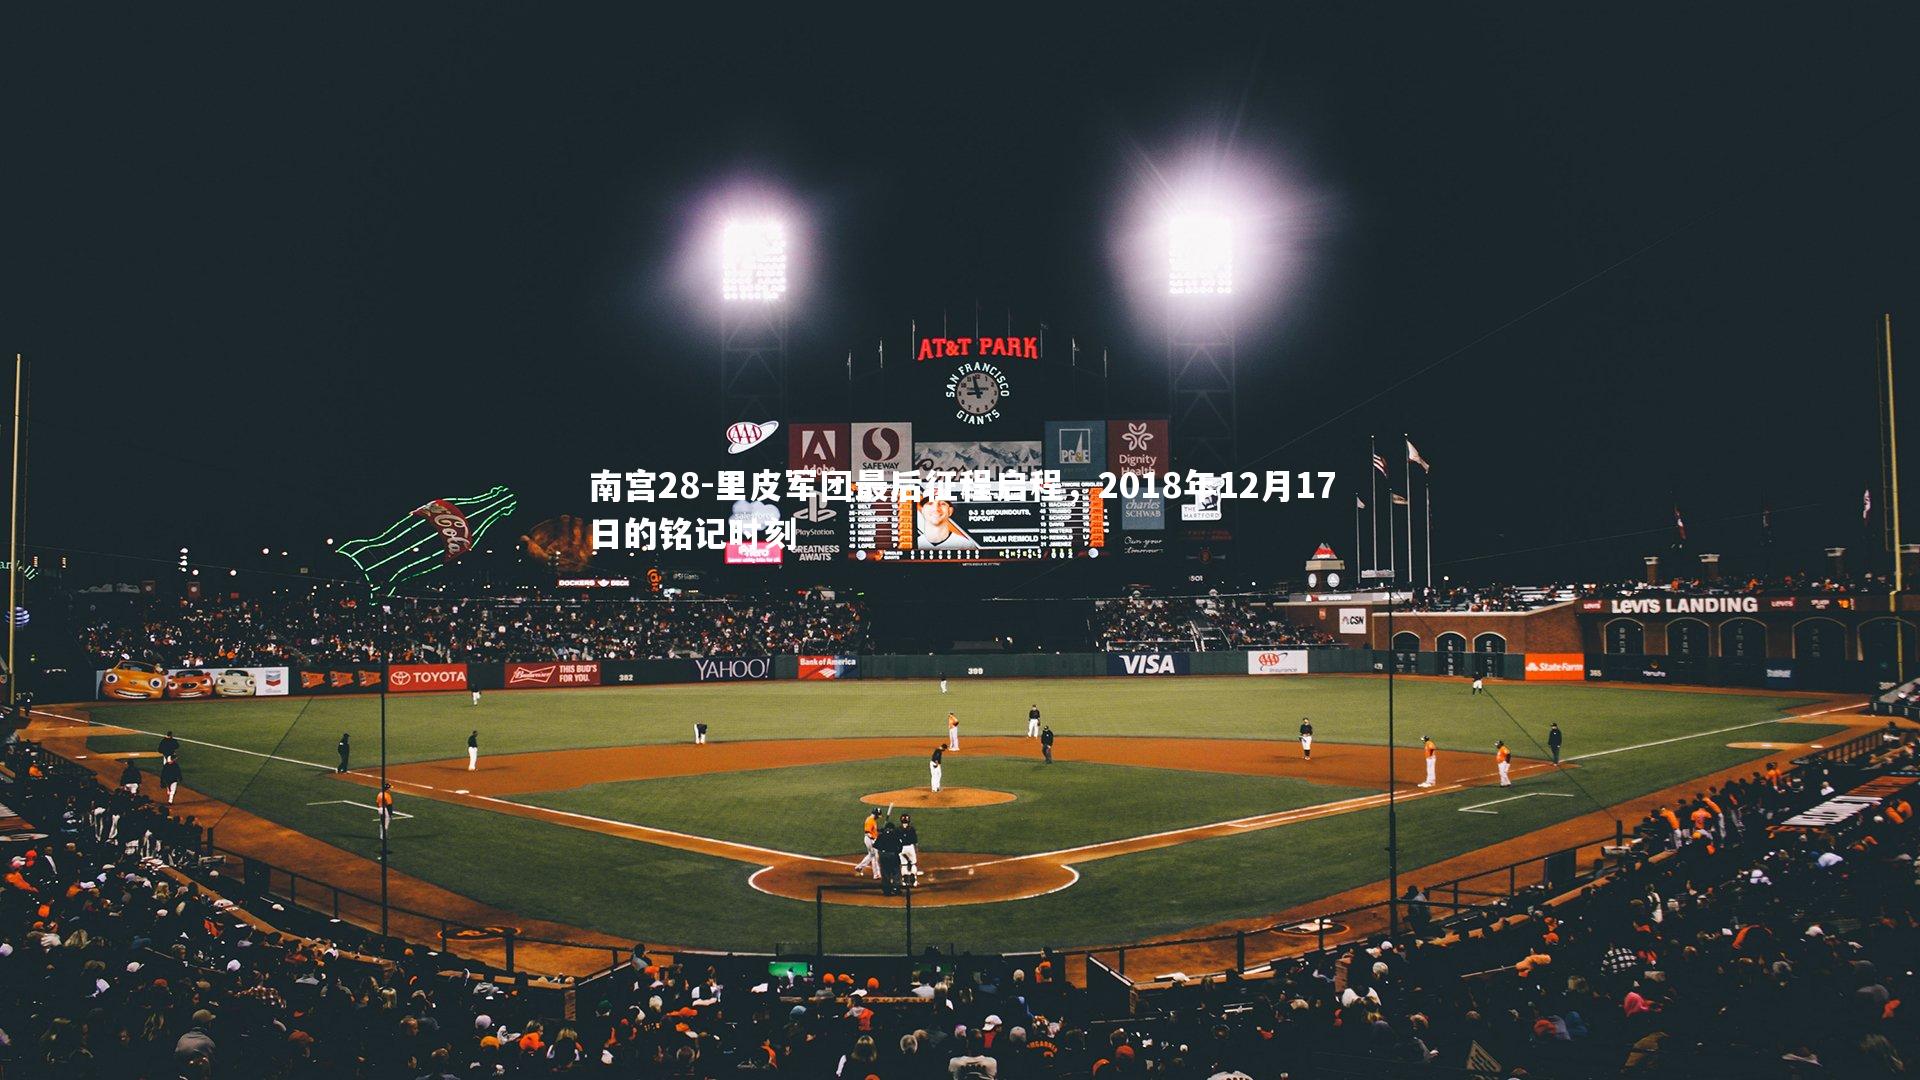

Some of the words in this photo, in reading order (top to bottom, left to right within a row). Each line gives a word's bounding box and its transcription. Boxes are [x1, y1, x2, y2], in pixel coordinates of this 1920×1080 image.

[917, 337, 972, 360] AT&T
[979, 336, 1038, 359] PARK
[945, 374, 960, 398] SAN
[958, 361, 1010, 397] FRANCISCO
[956, 409, 1001, 425] GIANTS
[728, 423, 763, 444] AAA
[1061, 450, 1090, 463] PG&E
[1119, 454, 1158, 466] Dignity
[862, 462, 900, 470] SAFEWAY
[1121, 467, 1156, 477] Health
[1125, 499, 1160, 509] charles
[1125, 510, 1161, 518] SCHWAB
[796, 528, 835, 537] PlayStation
[791, 545, 840, 554] GREATNESS
[799, 554, 832, 562] AWAITS
[1666, 598, 1759, 613] LANDING
[1350, 616, 1364, 625] CSN
[800, 658, 819, 666] Bank
[820, 658, 827, 666] of
[827, 658, 856, 666] America
[1119, 654, 1176, 674] VISA
[1539, 662, 1562, 672] State
[1562, 662, 1584, 672] Farm
[560, 664, 574, 673] THIS
[576, 664, 598, 672] BUD'S
[695, 658, 770, 680] YAHOO!
[413, 671, 467, 682] TOYOTA
[515, 670, 551, 679] Budweiser
[560, 674, 574, 682] FOR
[574, 674, 590, 682] YOU.
